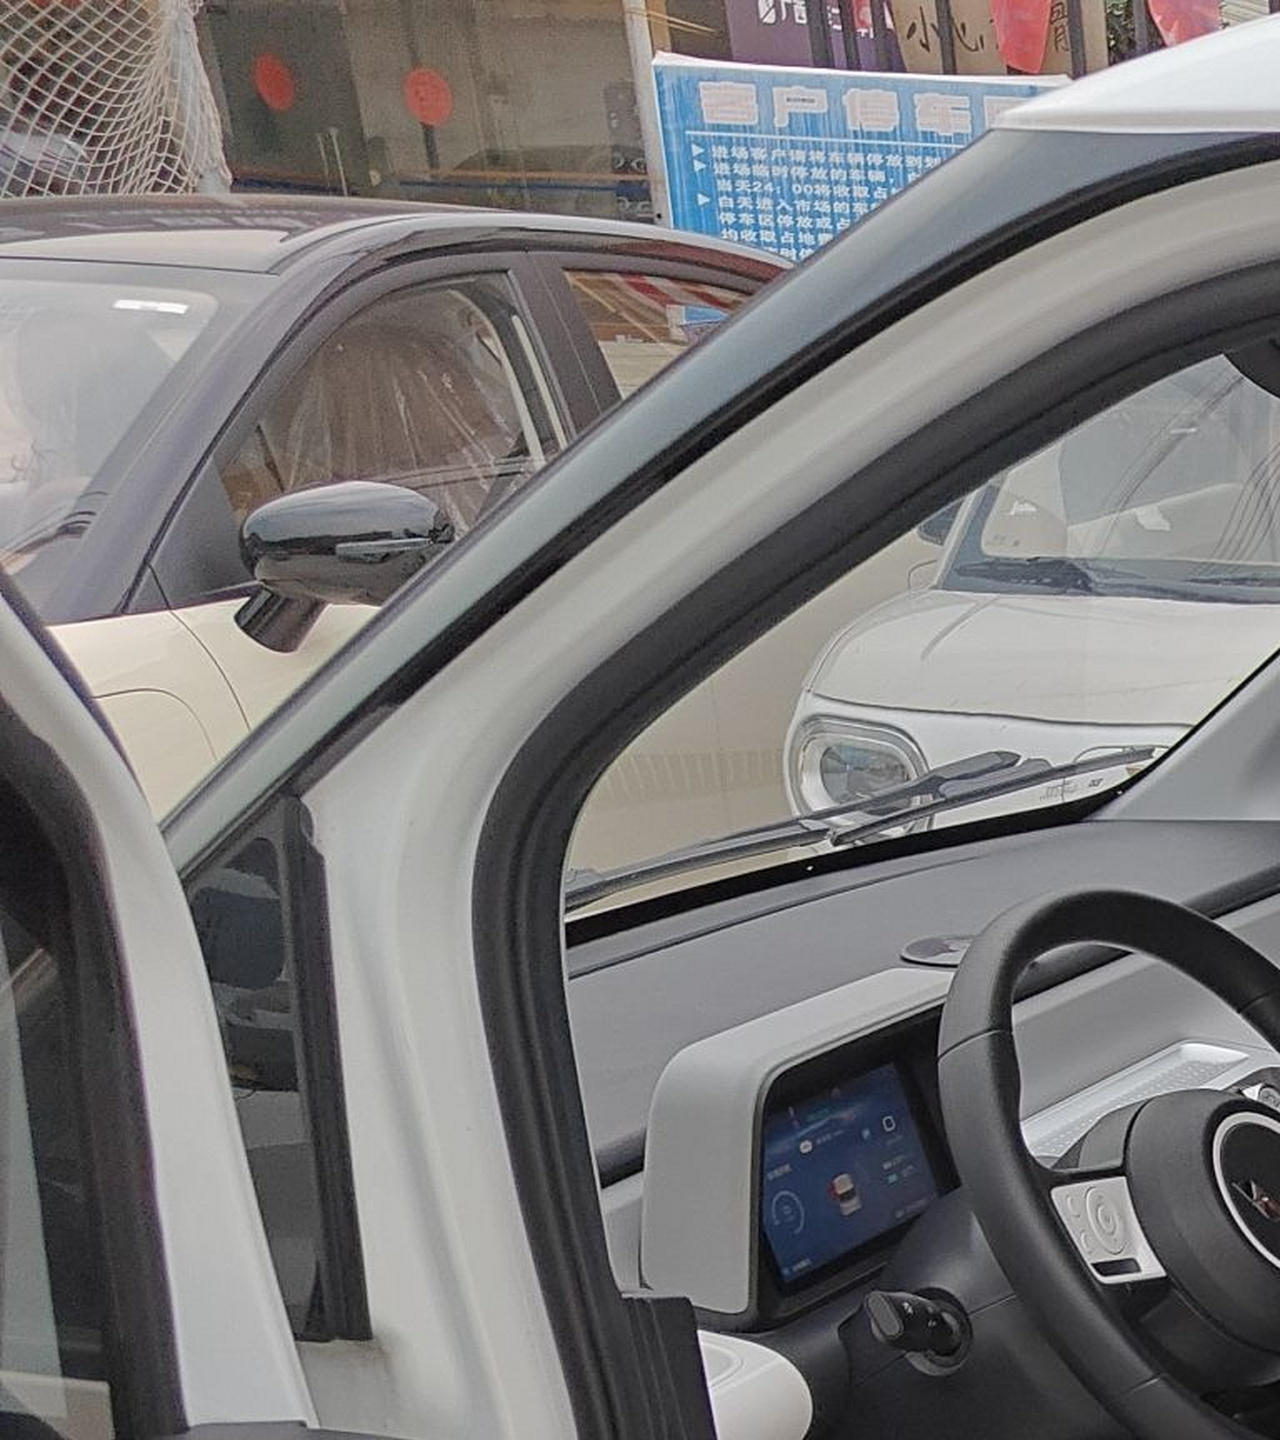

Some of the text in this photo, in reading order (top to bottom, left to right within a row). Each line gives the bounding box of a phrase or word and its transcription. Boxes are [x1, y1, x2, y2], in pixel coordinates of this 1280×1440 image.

[699, 80, 1032, 136] 客户停车
[718, 195, 881, 215] 白天进入市场的车
